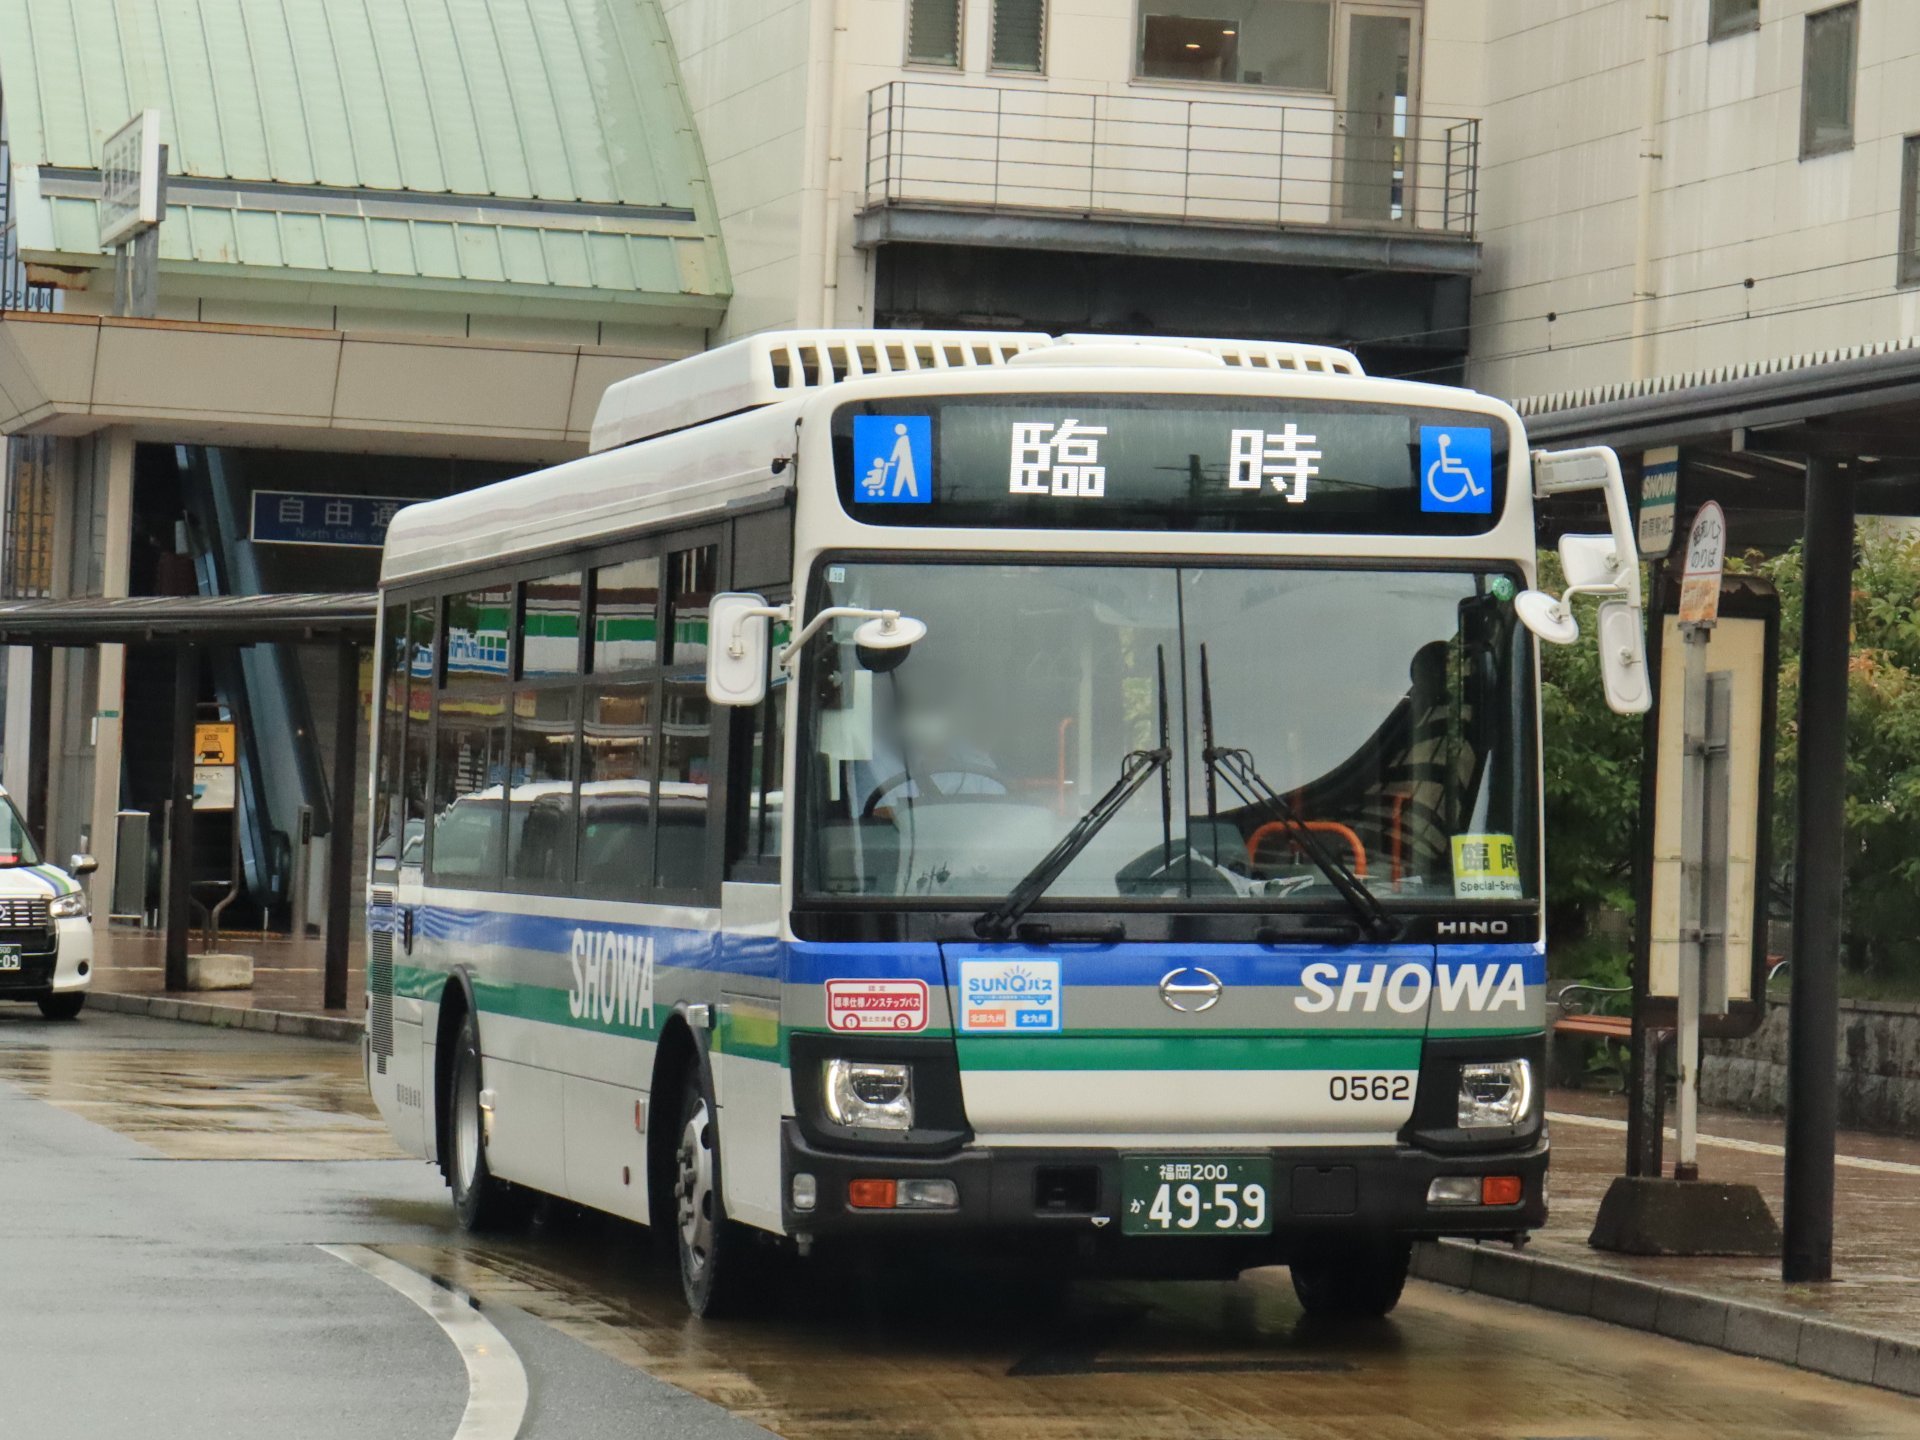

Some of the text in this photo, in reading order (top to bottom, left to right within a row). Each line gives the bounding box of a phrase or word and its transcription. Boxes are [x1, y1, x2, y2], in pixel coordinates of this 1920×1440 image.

[1642, 471, 1677, 500] SHOWA
[295, 527, 330, 539] North
[335, 528, 367, 540] Gate
[1691, 548, 1716, 569] のりば
[1437, 921, 1509, 934] HINO
[569, 928, 654, 1029] SHOWA
[1294, 963, 1526, 1013] SHOWA
[834, 997, 920, 1008] 標準仕様ノンステップバス
[970, 1014, 1004, 1023] 北部九州
[1022, 1014, 1047, 1023] 全九州
[1329, 1076, 1410, 1101] 0562
[1130, 1184, 1265, 1228] か 49-59
